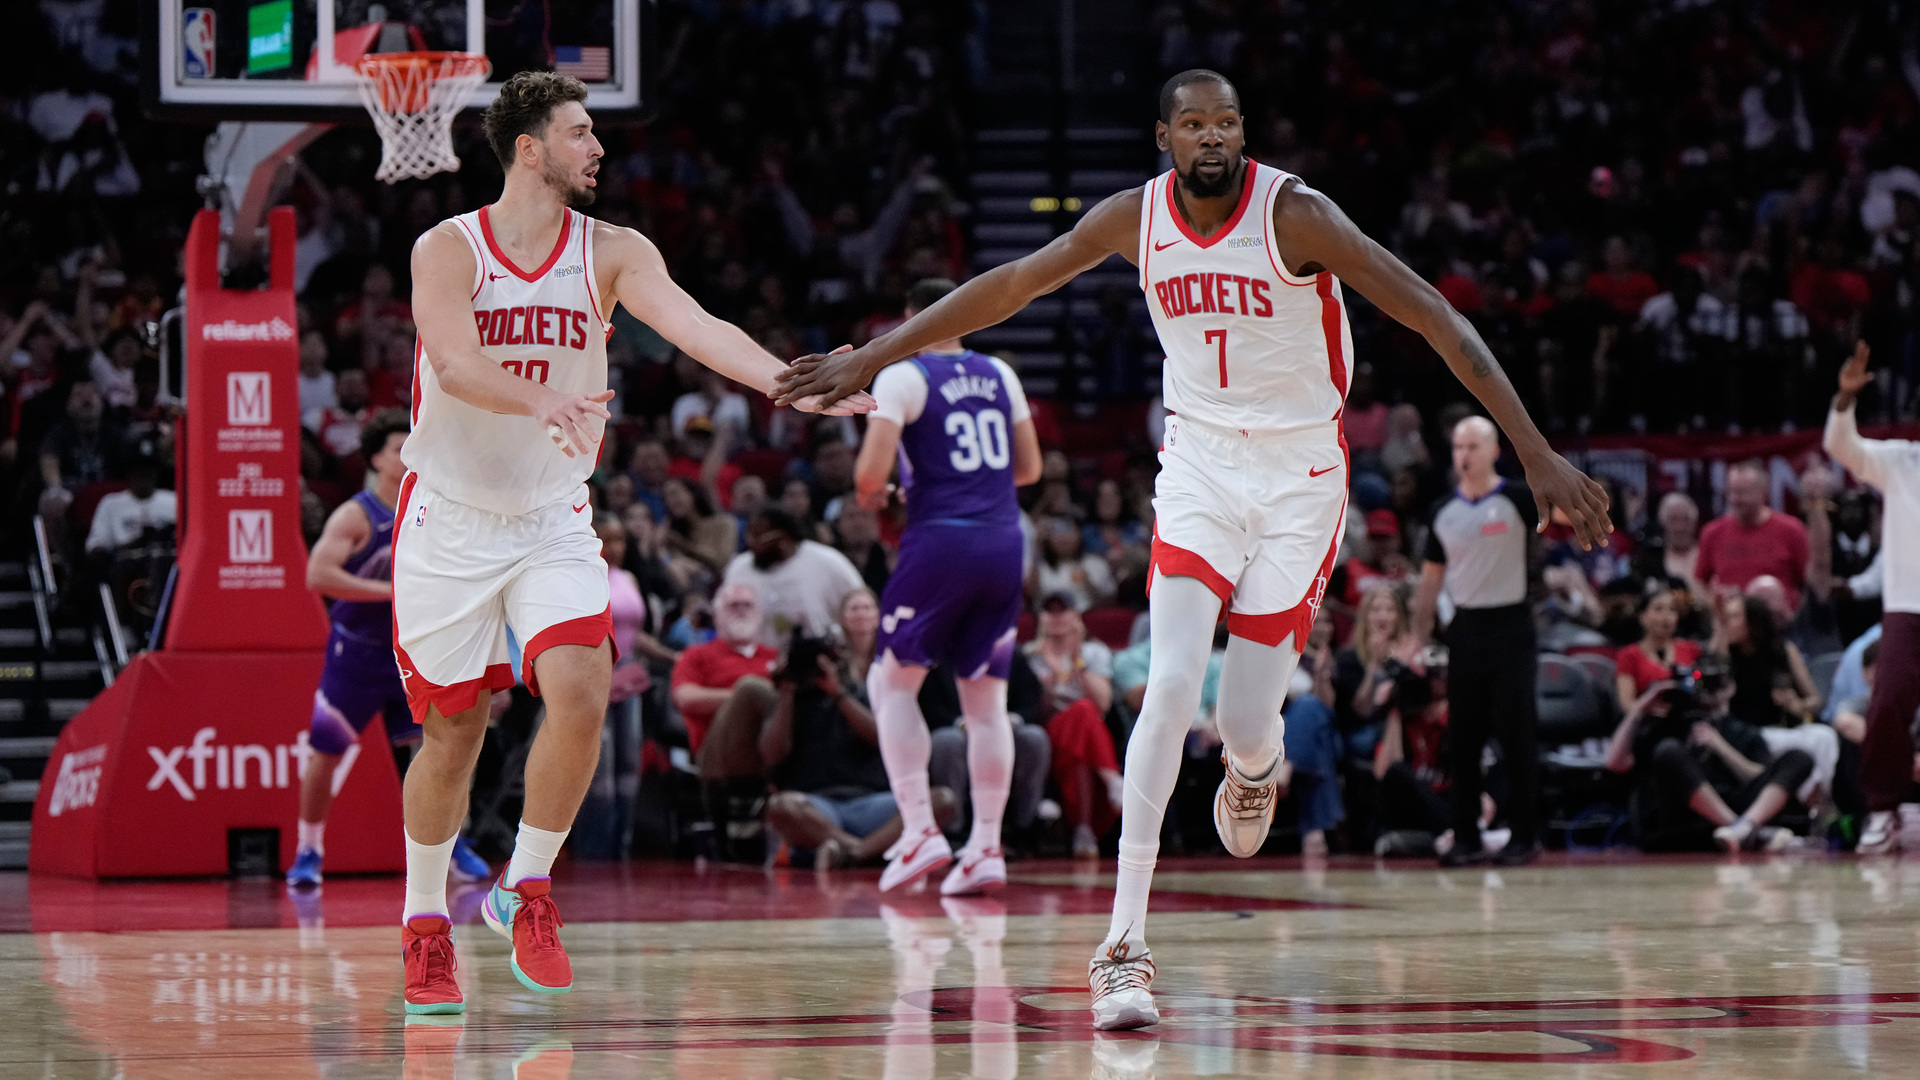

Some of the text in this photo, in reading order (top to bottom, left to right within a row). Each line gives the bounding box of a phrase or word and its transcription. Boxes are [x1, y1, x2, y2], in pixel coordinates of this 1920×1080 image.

[1228, 240, 1264, 249] HERMANN
[1155, 272, 1273, 319] ROCKETS
[203, 319, 270, 341] reliant
[474, 305, 588, 351] ROCKETS
[1204, 329, 1228, 389] 7
[945, 408, 1010, 472] 30
